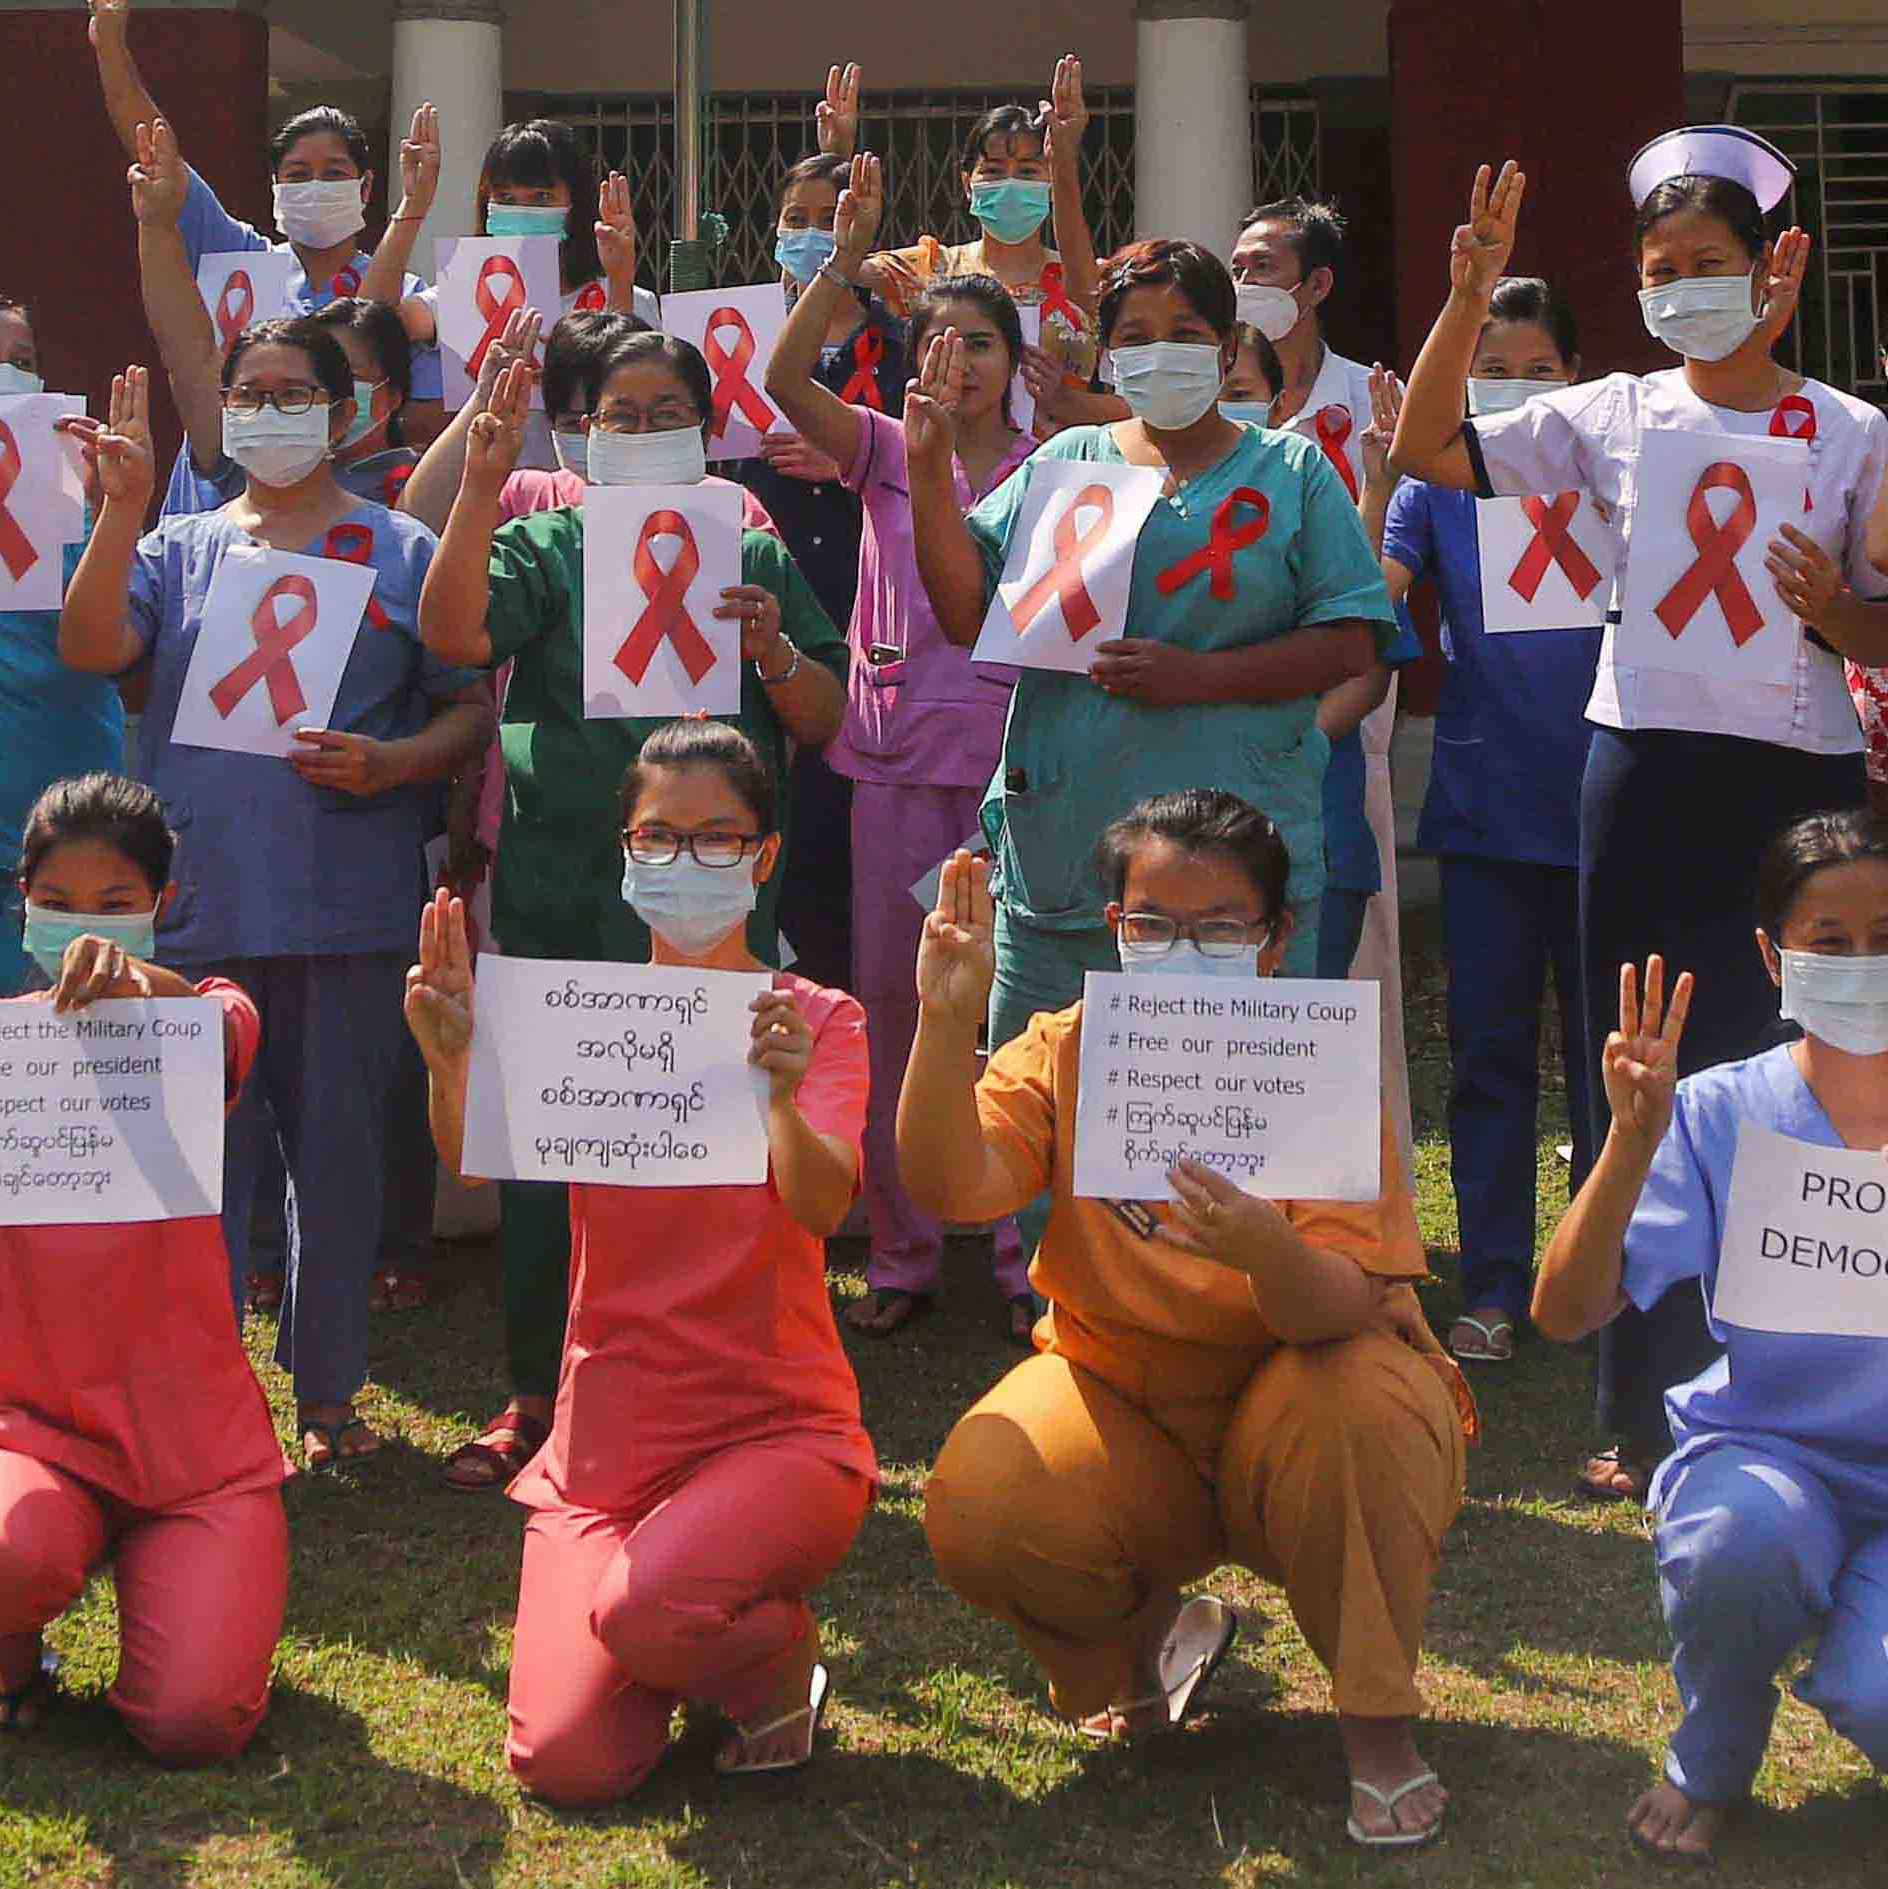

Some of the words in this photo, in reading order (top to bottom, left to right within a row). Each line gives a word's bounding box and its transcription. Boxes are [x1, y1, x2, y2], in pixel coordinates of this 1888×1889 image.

[1110, 995, 1121, 1011] #
[1128, 995, 1187, 1017] Reject
[1193, 997, 1223, 1017] the
[1231, 999, 1299, 1024] Military
[1306, 1002, 1357, 1028] Coup
[38, 1021, 69, 1039] the
[75, 1018, 145, 1040] Military
[152, 1019, 202, 1041] Coup
[1109, 1032, 1120, 1049] #
[1127, 1032, 1168, 1051] Free
[1182, 1038, 1214, 1053] our
[1226, 1037, 1318, 1059] president
[26, 1063, 60, 1077] our
[72, 1057, 162, 1079] president
[1107, 1070, 1119, 1086] #
[1127, 1069, 1203, 1095] Respect
[1215, 1076, 1247, 1093] our
[1254, 1076, 1305, 1095] votes
[60, 1099, 93, 1112] our
[99, 1095, 151, 1112] votes
[1106, 1107, 1118, 1124] #
